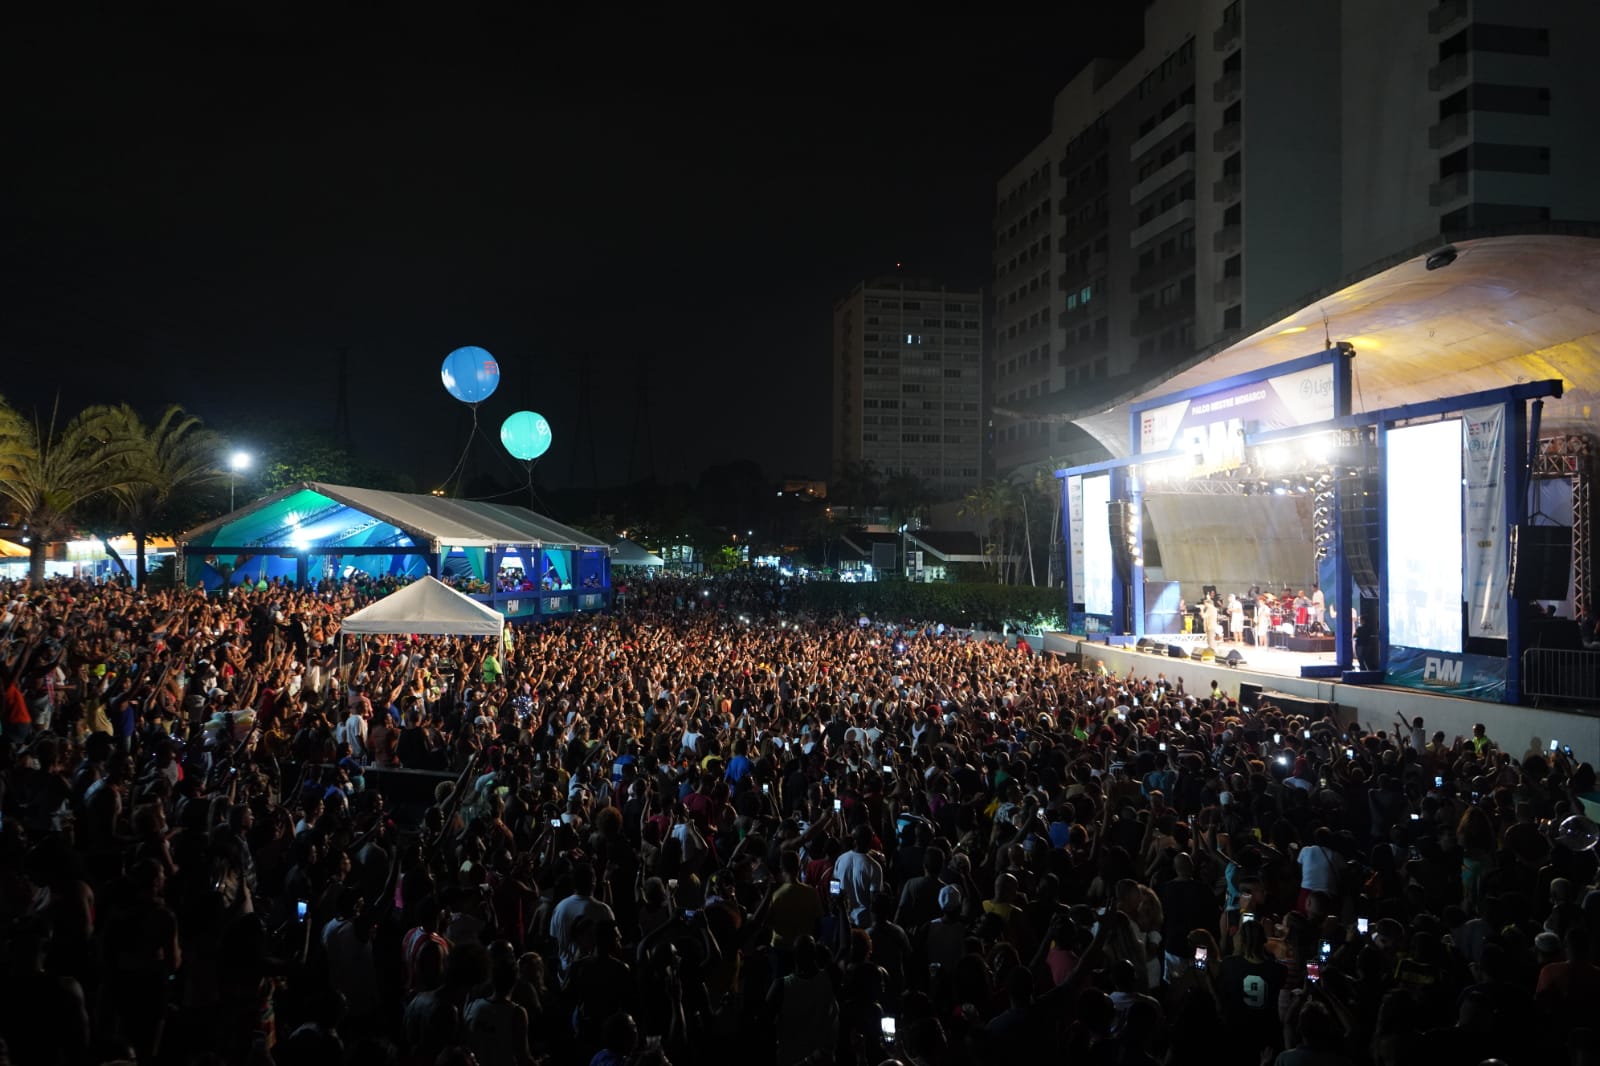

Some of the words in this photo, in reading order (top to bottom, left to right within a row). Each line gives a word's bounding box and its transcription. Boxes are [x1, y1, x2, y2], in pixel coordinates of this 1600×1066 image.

[1314, 376, 1333, 397] Ligh
[1191, 404, 1210, 416] PALCO
[1211, 397, 1234, 412] MESTRE
[1424, 656, 1463, 683] FVM
[1243, 974, 1264, 1007] 9
